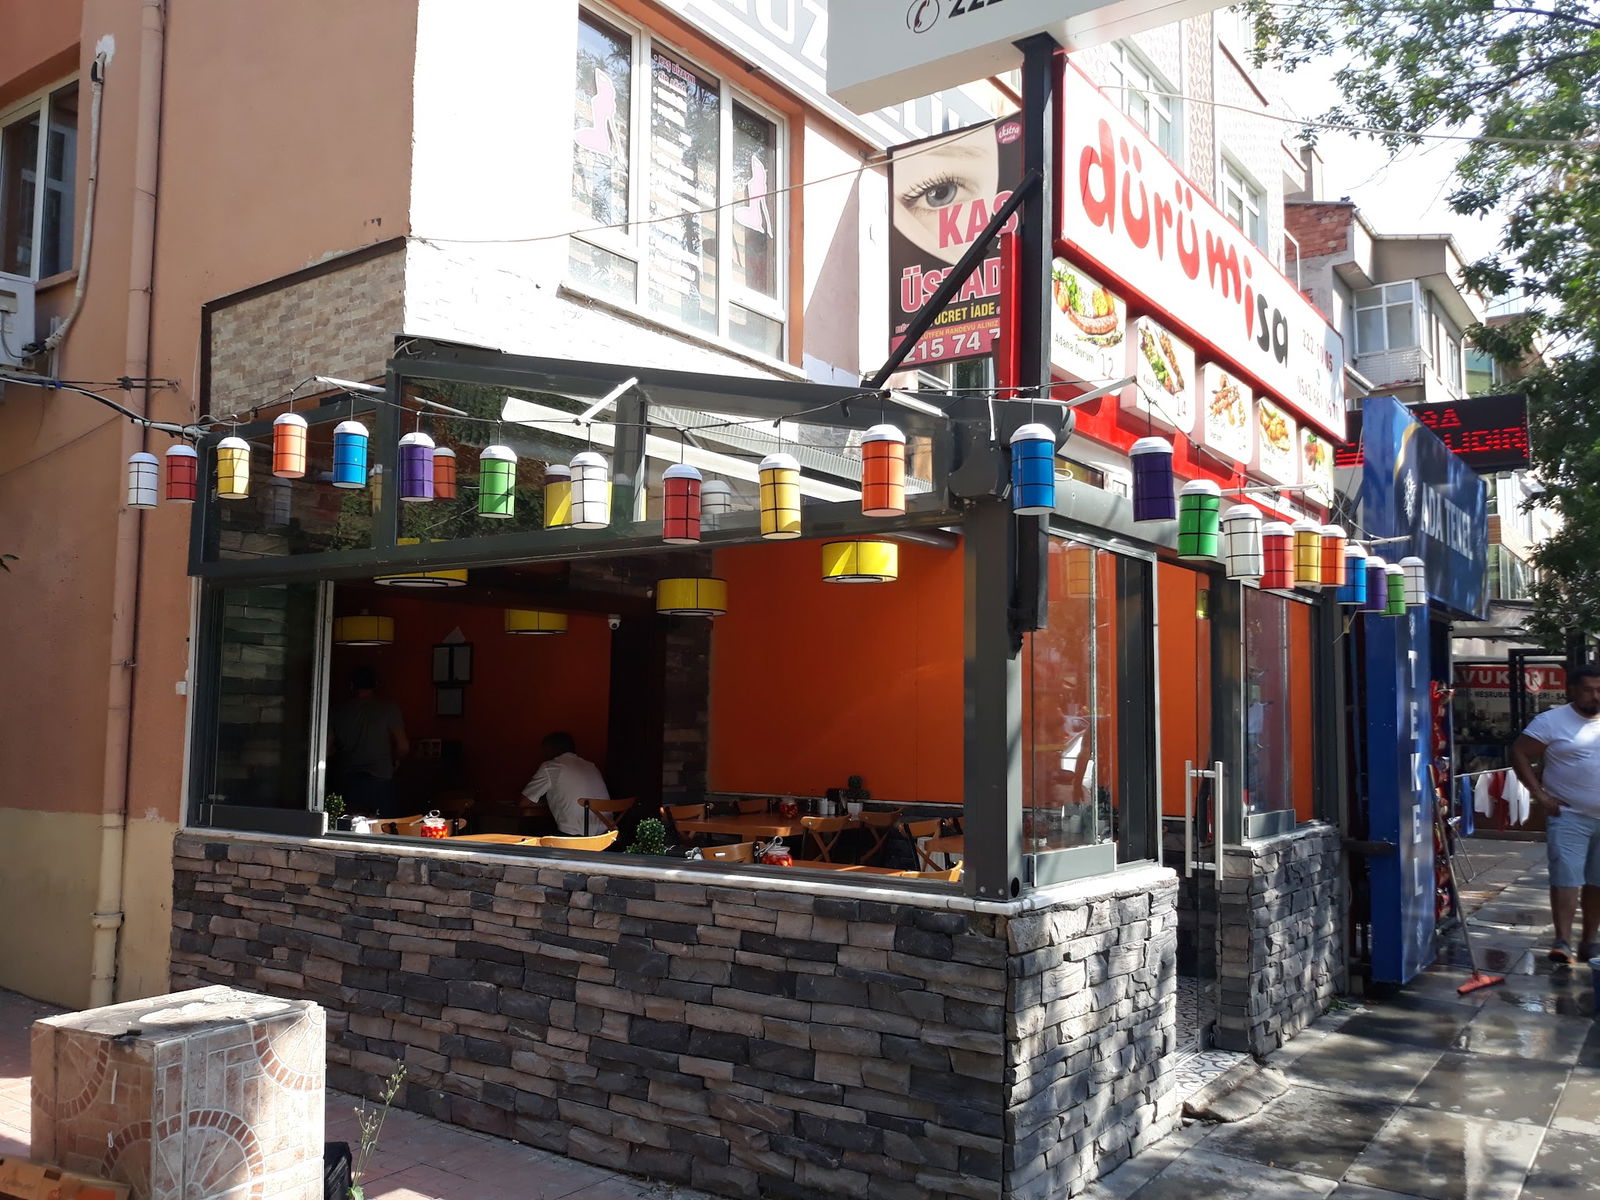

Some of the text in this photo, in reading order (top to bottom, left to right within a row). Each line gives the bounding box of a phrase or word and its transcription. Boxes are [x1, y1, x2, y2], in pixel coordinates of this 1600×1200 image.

[953, 331, 981, 354] 74
[1421, 481, 1444, 543] ADA
[1408, 649, 1423, 897] TEKEL
